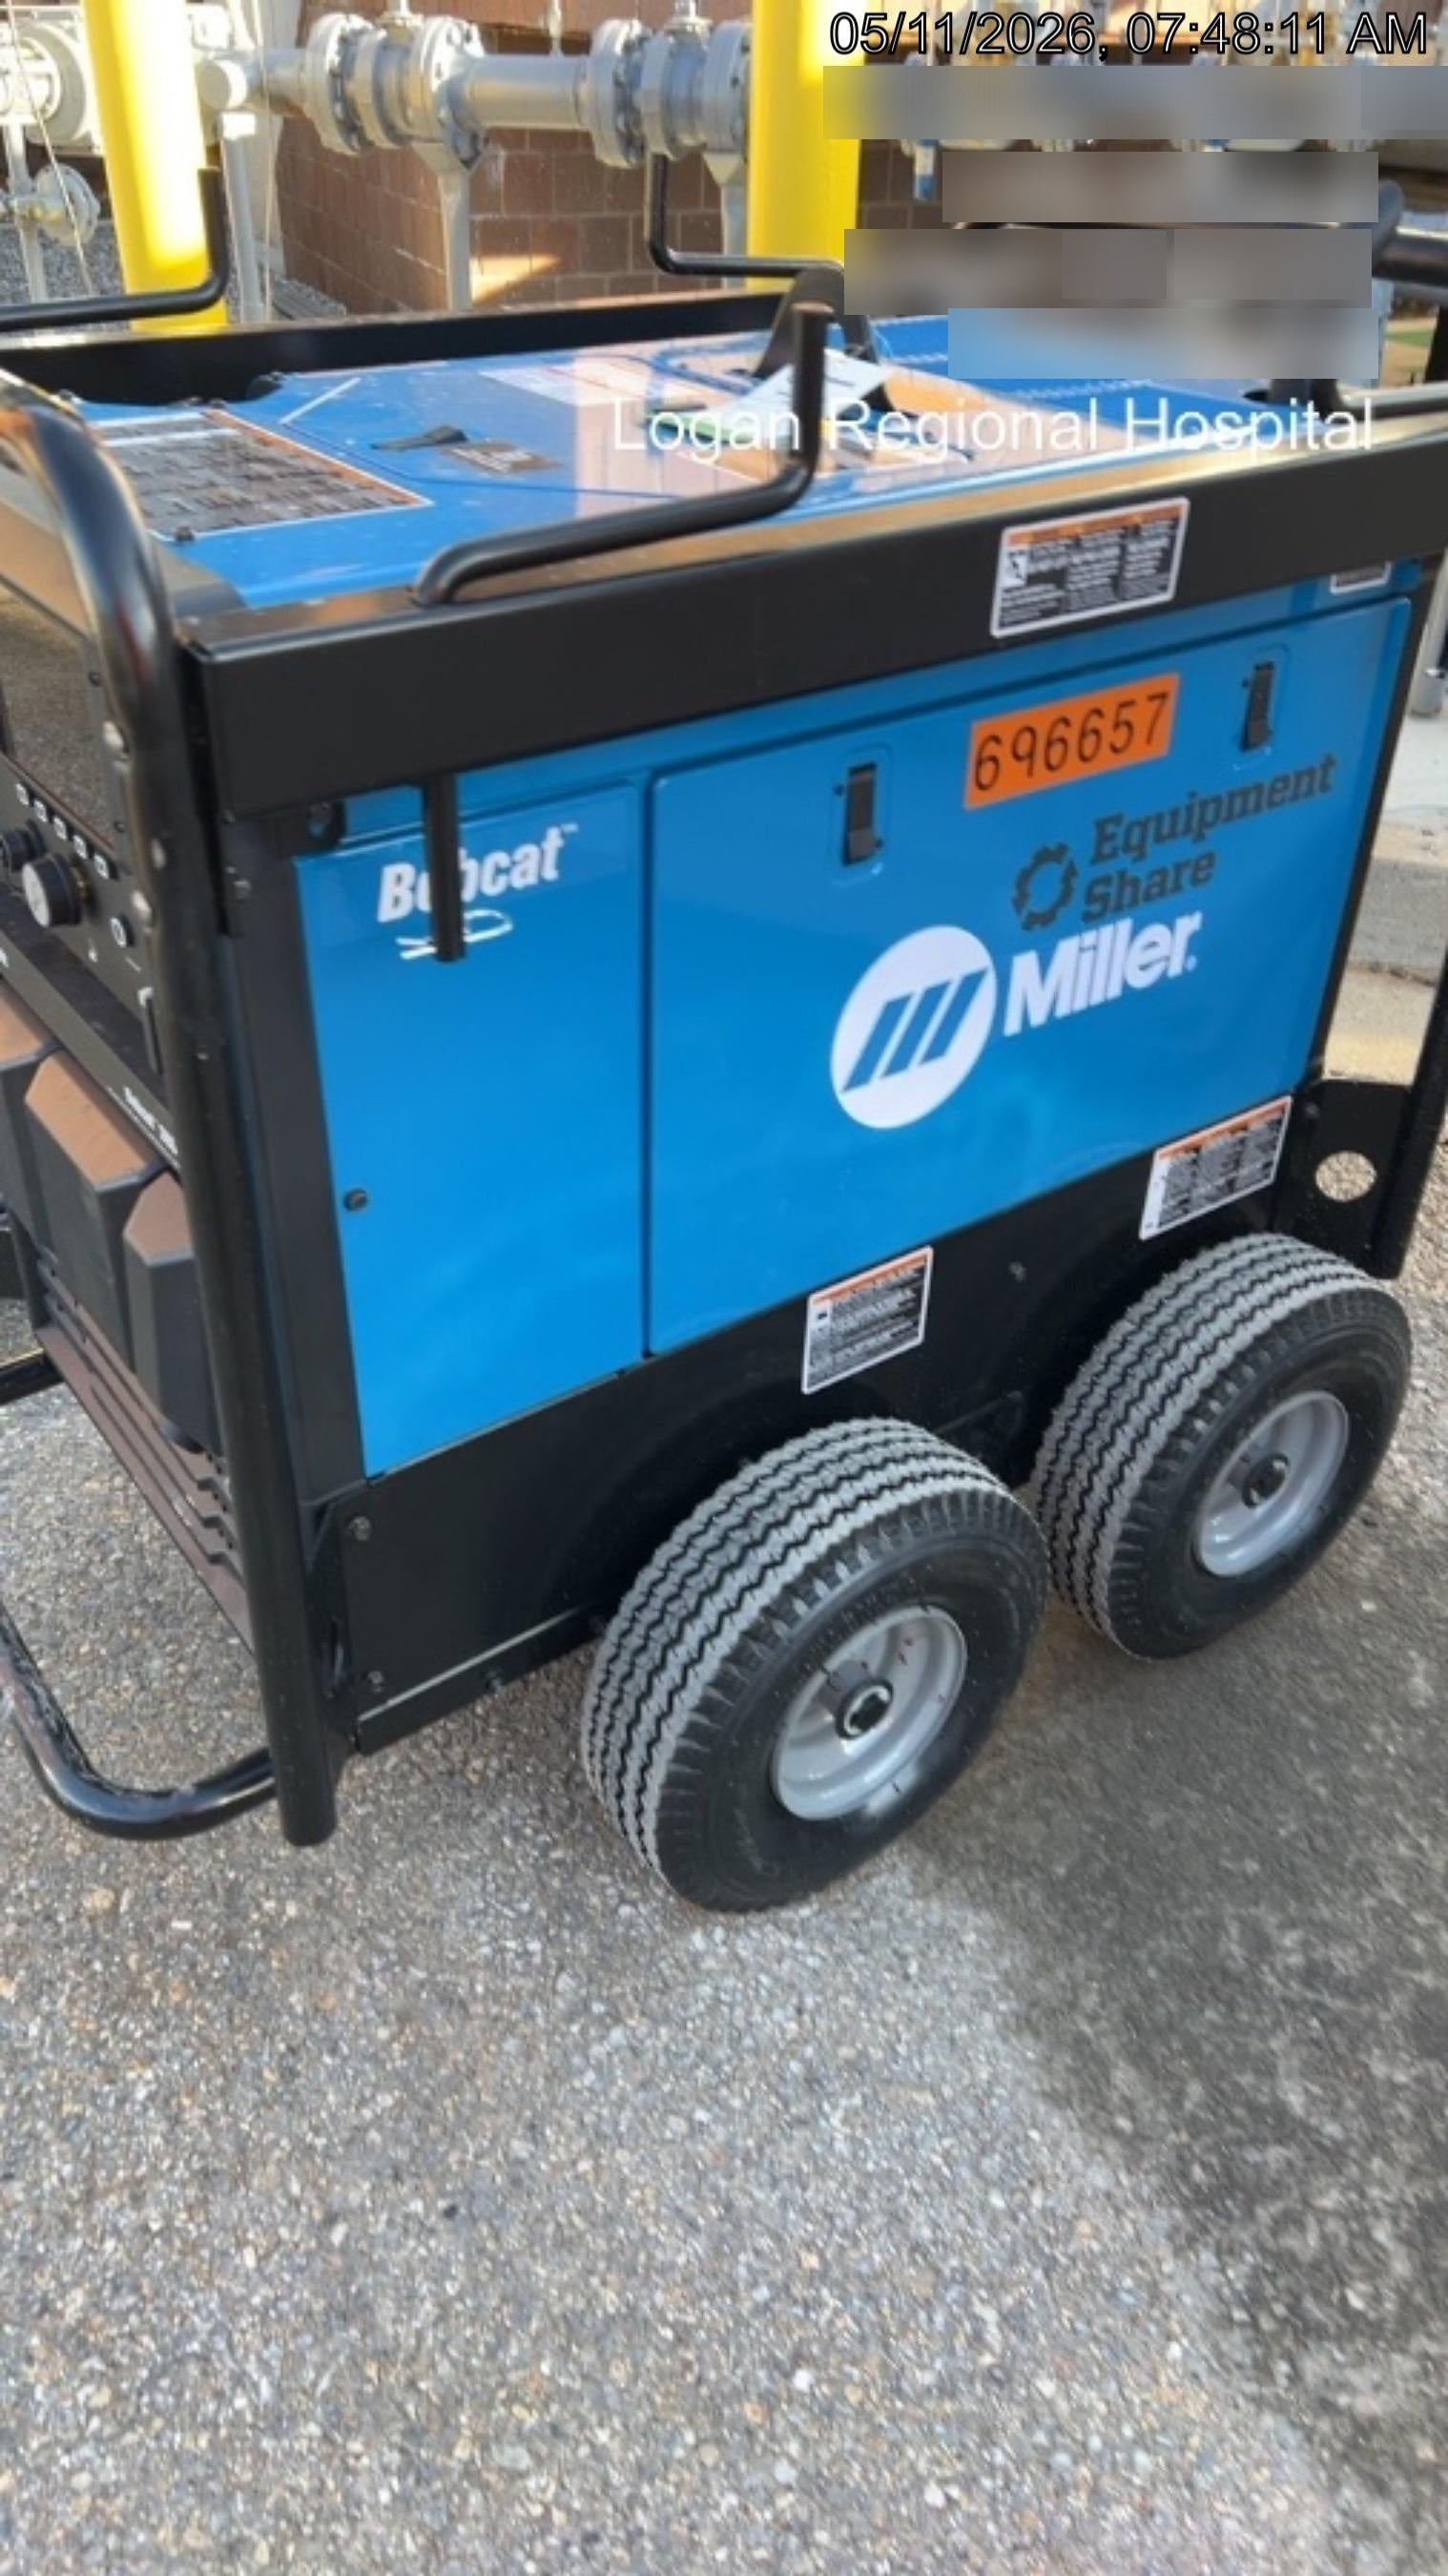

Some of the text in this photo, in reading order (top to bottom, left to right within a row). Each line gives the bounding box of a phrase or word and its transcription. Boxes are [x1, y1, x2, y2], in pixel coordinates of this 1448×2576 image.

[974, 691, 1169, 792] 696657
[1090, 752, 1337, 863] Equipment
[1080, 851, 1216, 923] Share
[1003, 909, 1204, 1038] Miller
